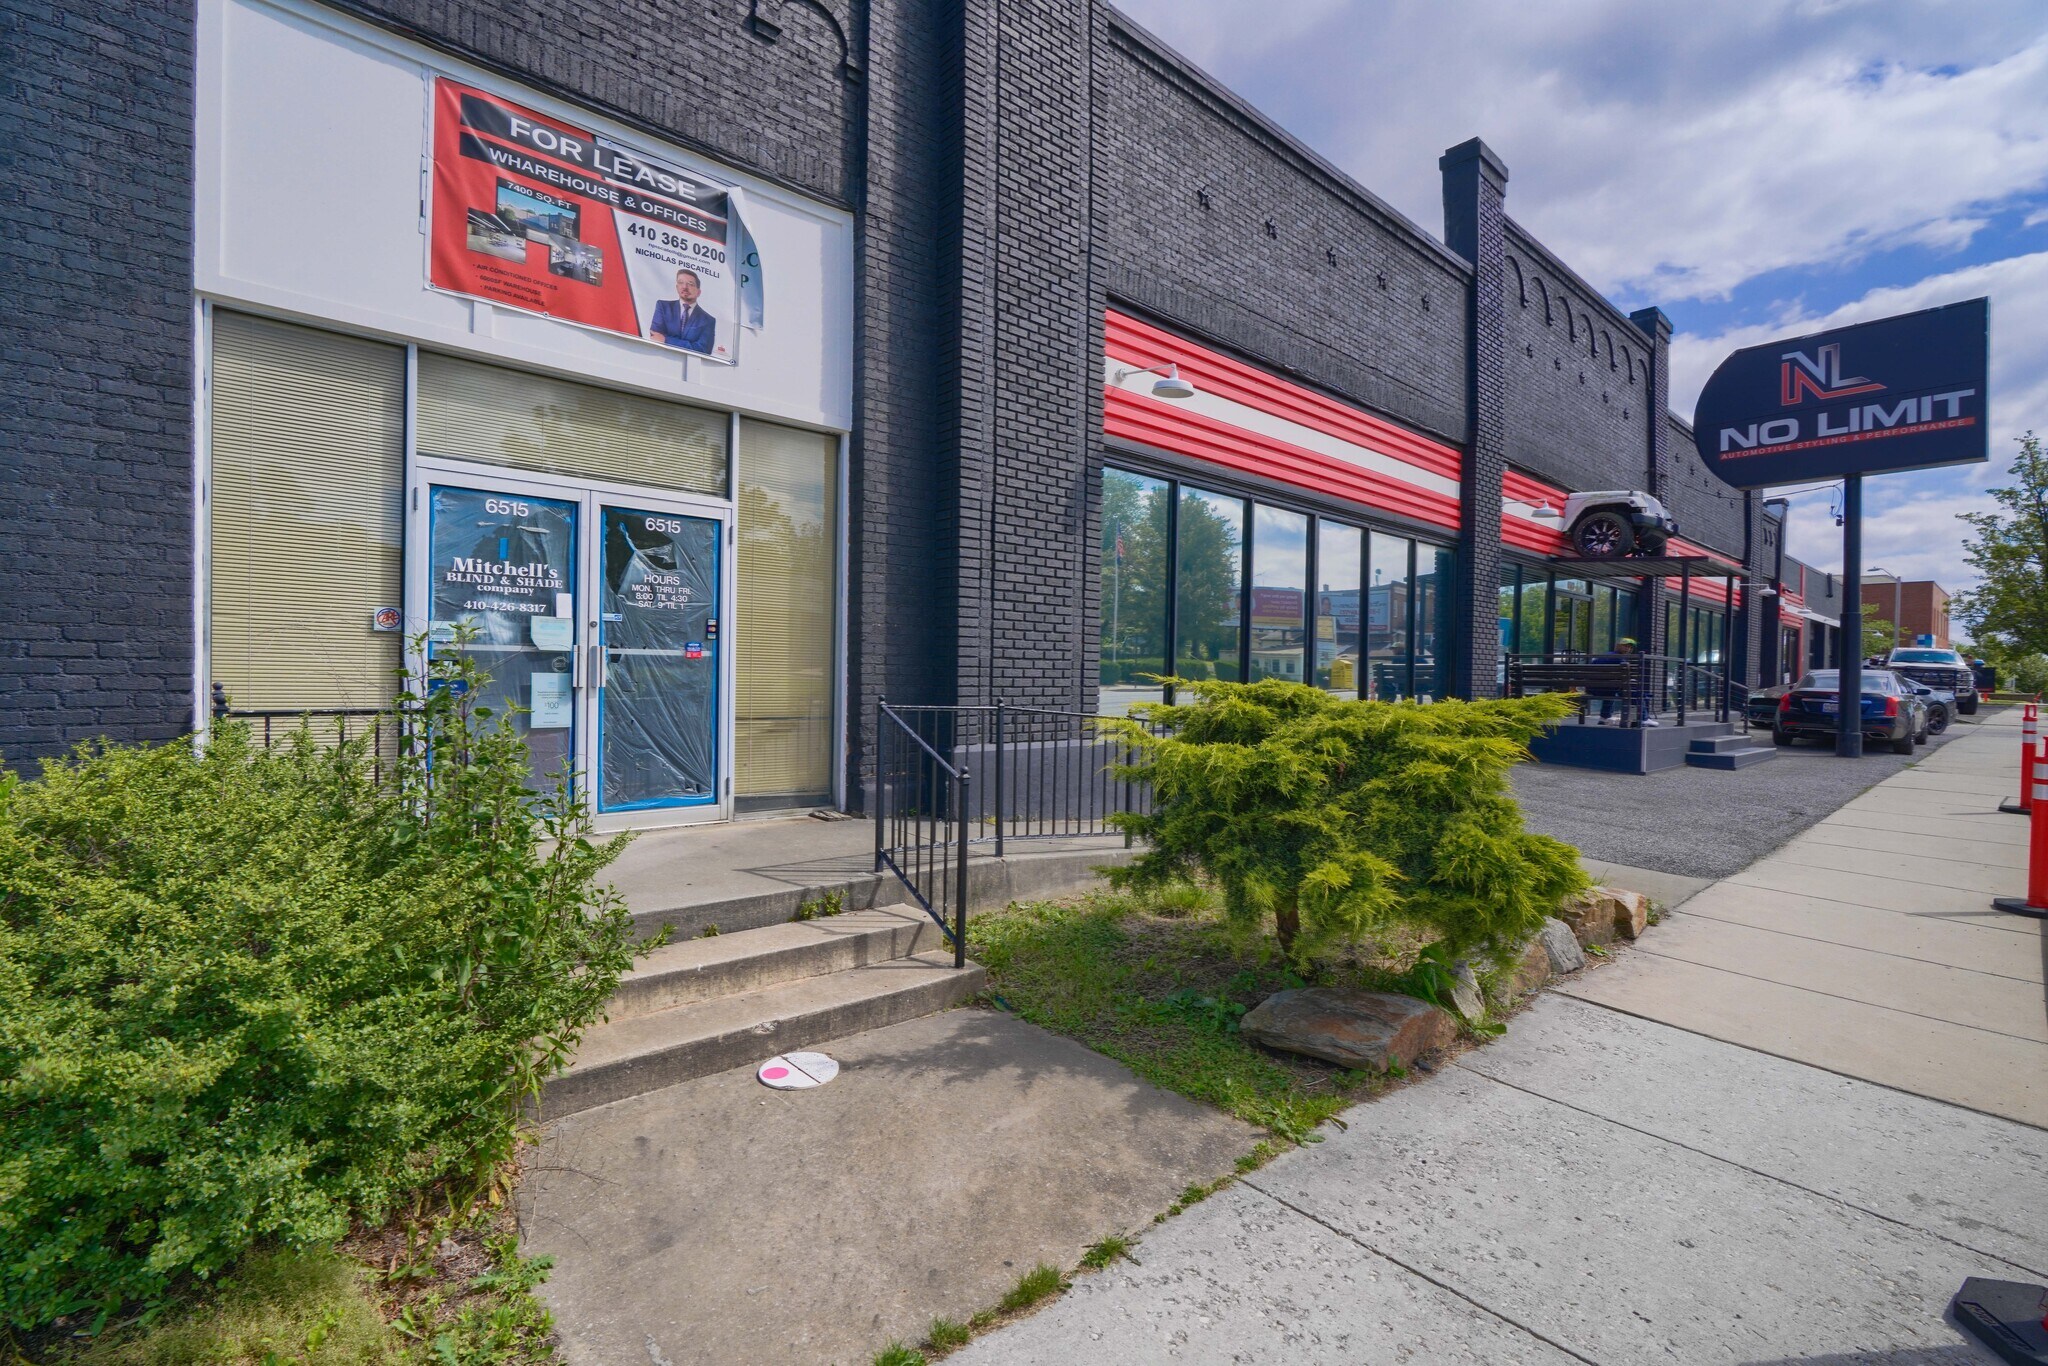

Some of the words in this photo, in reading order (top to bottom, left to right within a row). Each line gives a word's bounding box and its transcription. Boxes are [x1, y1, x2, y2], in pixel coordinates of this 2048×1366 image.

[510, 117, 582, 161] FOR
[594, 149, 697, 201] LEASE
[489, 147, 619, 204] WHAREHOUSE
[625, 196, 636, 208] &
[641, 201, 707, 232] OFFICES
[508, 182, 533, 197] 7400
[536, 192, 555, 205] SQ.
[558, 199, 572, 209] FT
[627, 222, 656, 240] 410
[661, 232, 688, 251] 365
[693, 243, 725, 264] 0200
[635, 247, 676, 265] NICHOLAS
[678, 260, 720, 279] PISCATELLI
[490, 267, 532, 283] CONDITIONED
[533, 279, 558, 291] OFFICES
[503, 281, 541, 296] WAREHOUSE
[484, 285, 512, 297] PARKING
[513, 293, 545, 307] AVAILABLE
[1720, 418, 1799, 451] NO
[1817, 388, 1975, 437] LIMIT
[1720, 443, 1791, 460] AUTOMOTIVE
[1797, 435, 1847, 449] STYLING
[1853, 433, 1861, 441] &
[1866, 418, 1965, 439] PERFORMANCE
[485, 498, 529, 517] 6515
[645, 517, 681, 533] 6515
[451, 556, 558, 579] Mitchell's
[446, 572, 494, 584] BLIND
[500, 576, 510, 586] &
[516, 577, 563, 589] SHADE
[477, 584, 535, 596] company
[631, 584, 652, 592] MON.
[655, 586, 676, 594] THRU
[644, 574, 680, 586] HOURS
[463, 600, 547, 613] 410-426-8317
[635, 593, 653, 601] 8:00
[657, 594, 668, 602] TIL
[670, 595, 688, 603] 4:30
[638, 600, 654, 608] SAT.
[657, 601, 664, 609] 9
